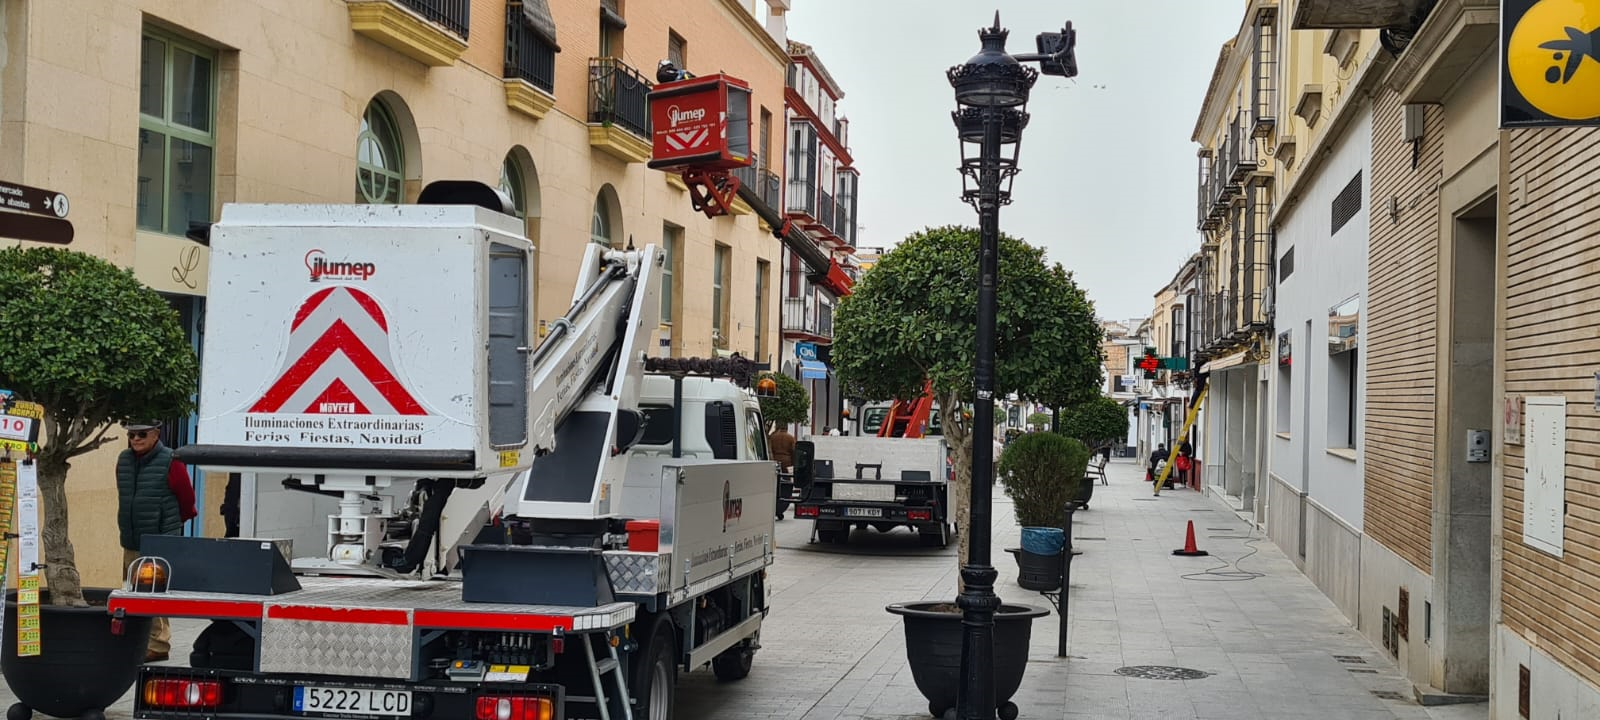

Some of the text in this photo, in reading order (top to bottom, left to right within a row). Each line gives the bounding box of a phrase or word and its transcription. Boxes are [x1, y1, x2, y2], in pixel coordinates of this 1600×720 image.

[669, 107, 705, 123] ilumep
[8, 198, 30, 209] abastos
[309, 255, 376, 281] ilumep
[245, 416, 424, 431] Iluminaciones Extraordinarias:
[359, 433, 422, 445] Navidad
[310, 688, 360, 710] 5222
[369, 691, 408, 712] LCD
